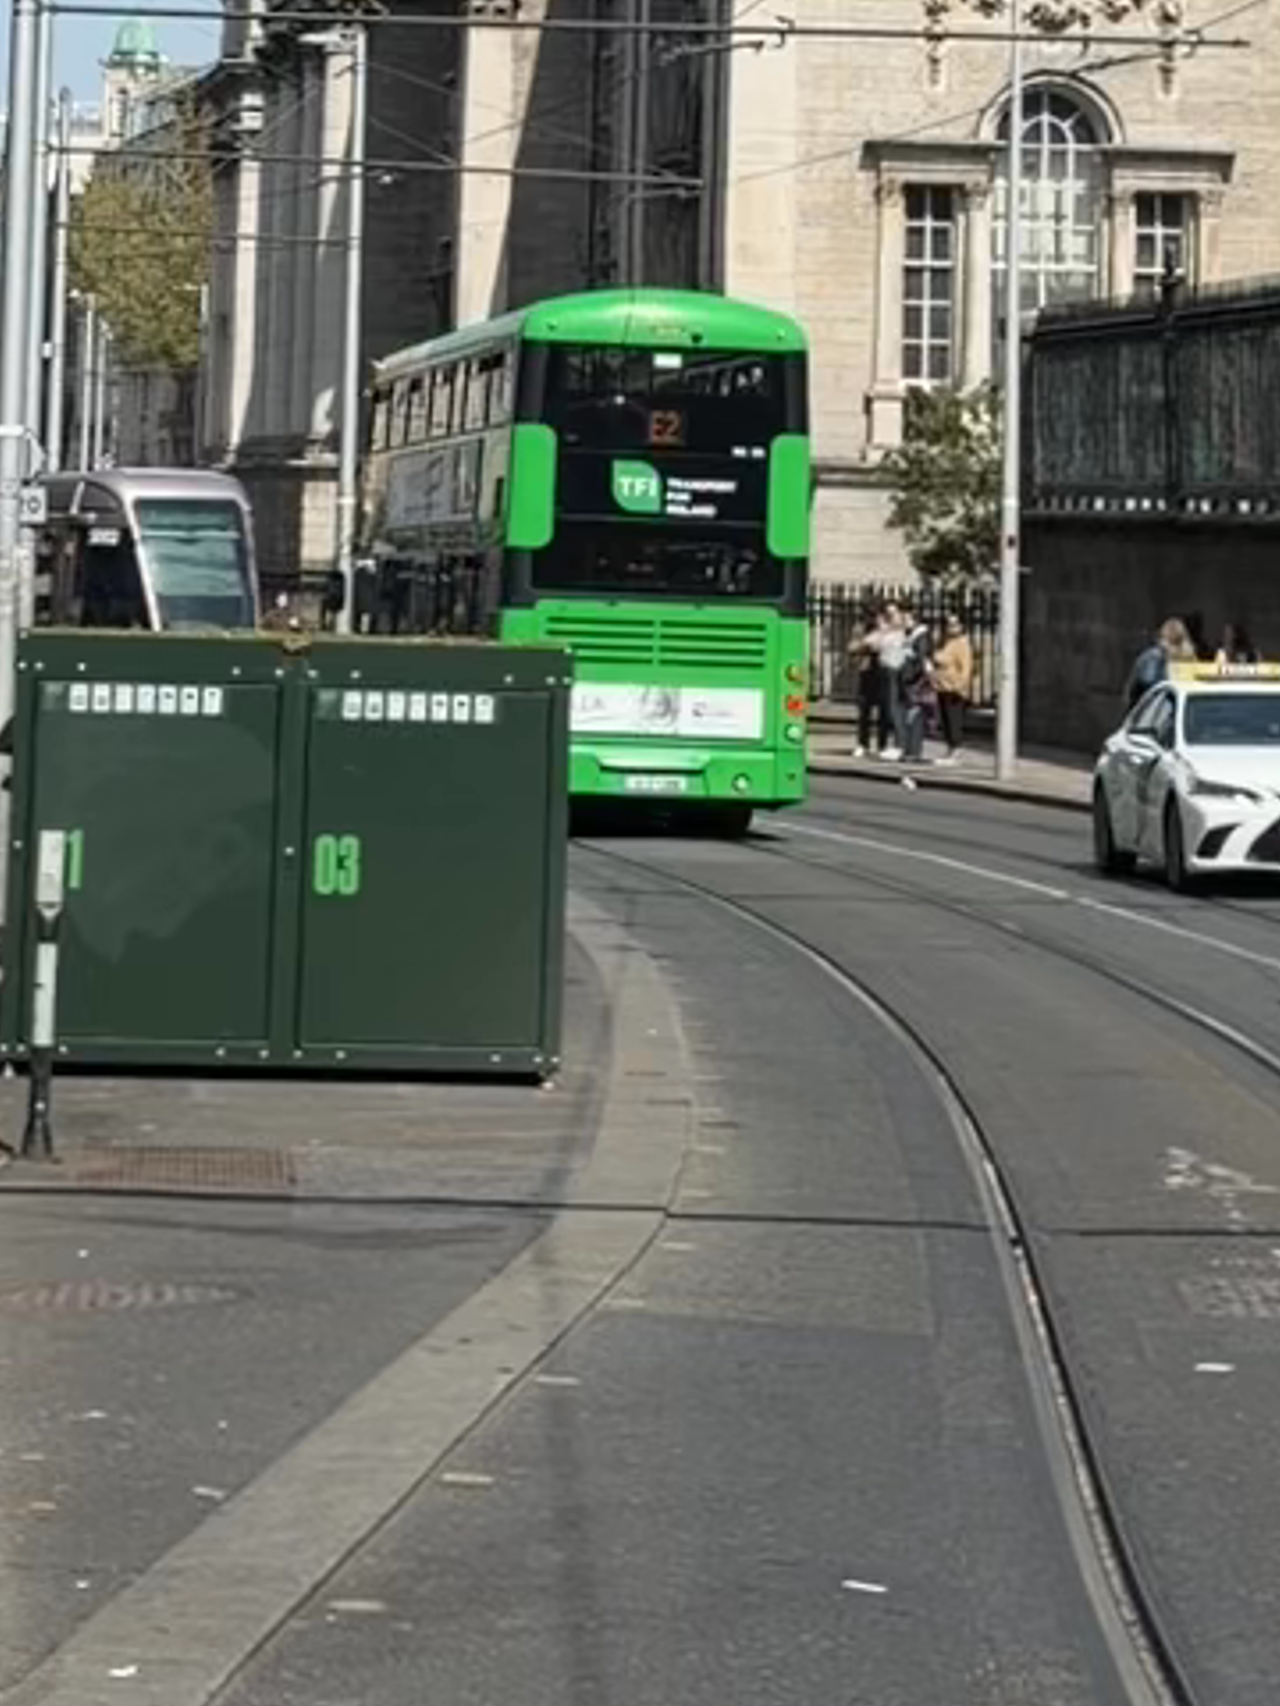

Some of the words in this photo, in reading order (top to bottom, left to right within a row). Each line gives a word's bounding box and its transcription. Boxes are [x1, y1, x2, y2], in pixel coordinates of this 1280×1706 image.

[620, 477, 657, 497] TFI
[66, 828, 85, 889] 1
[314, 834, 360, 896] 03
